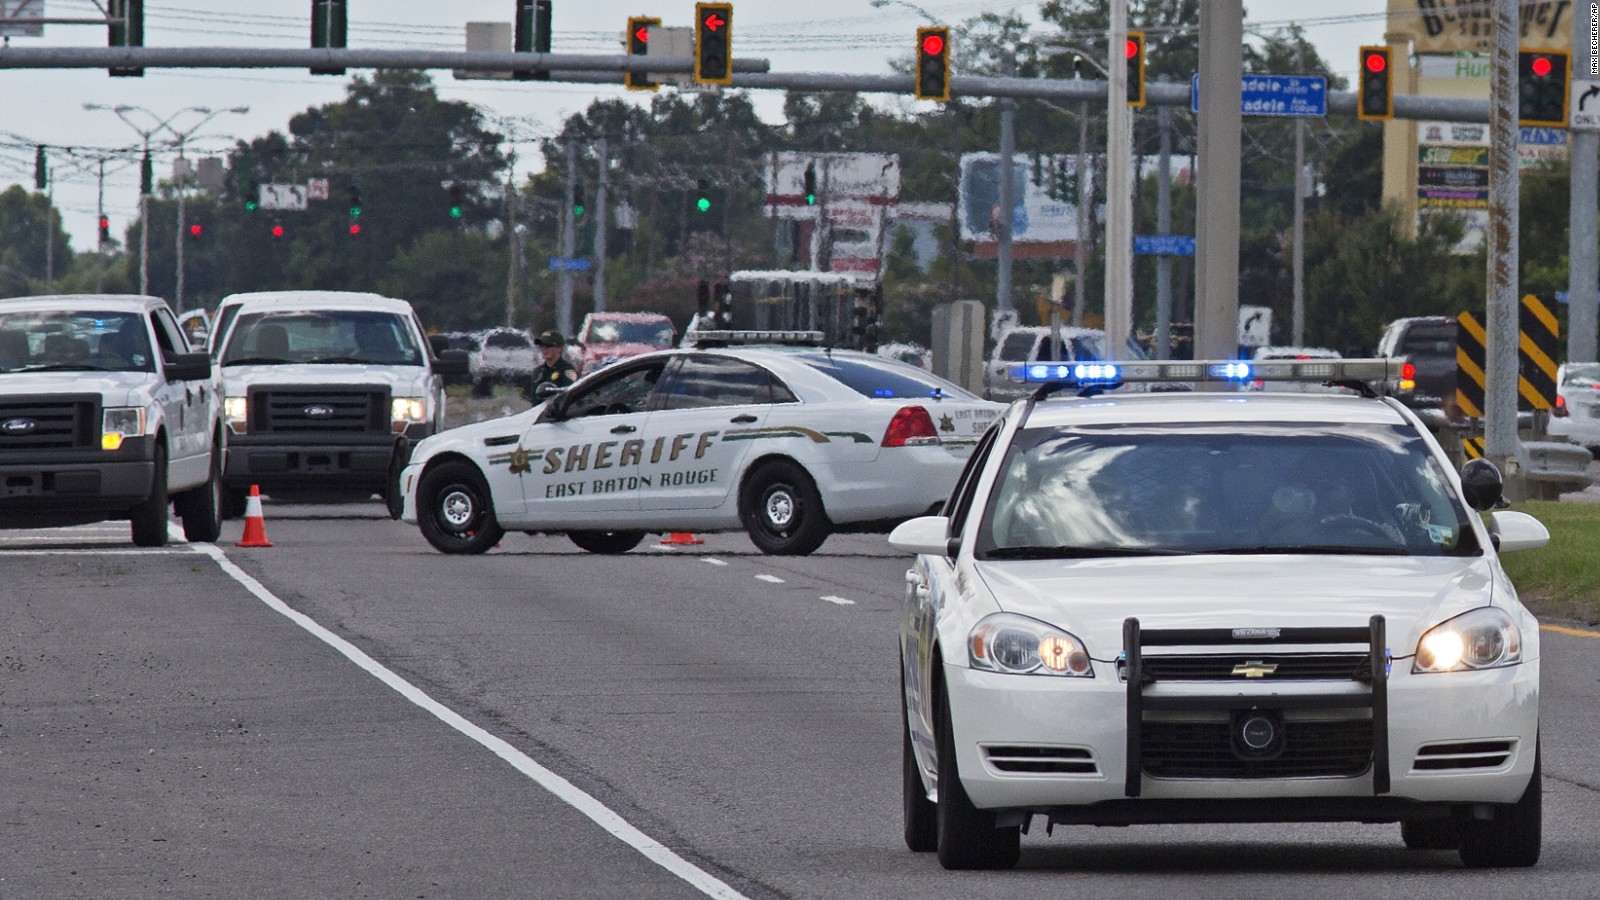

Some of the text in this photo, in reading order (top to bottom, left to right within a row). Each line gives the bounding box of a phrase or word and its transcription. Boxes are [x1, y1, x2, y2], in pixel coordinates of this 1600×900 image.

[1241, 79, 1281, 92] adele
[1244, 98, 1285, 111] adele
[543, 430, 720, 474] SHERIFF
[545, 468, 719, 499] EAST BATON ROUGE
